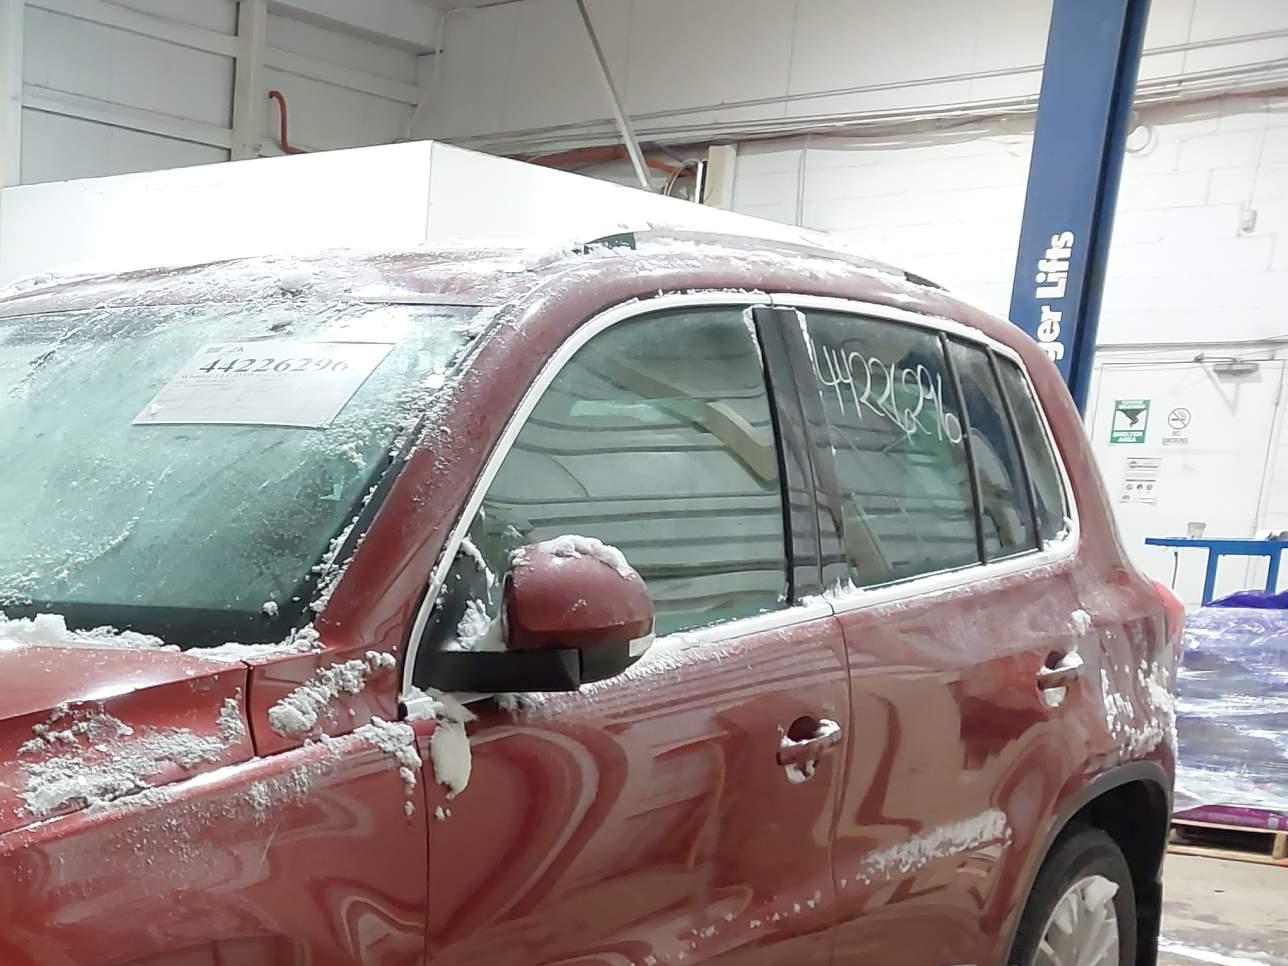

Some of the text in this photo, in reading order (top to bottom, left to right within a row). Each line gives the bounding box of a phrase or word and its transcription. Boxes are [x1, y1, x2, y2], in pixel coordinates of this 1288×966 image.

[1035, 231, 1074, 299] Lifts
[199, 357, 349, 373] 44226296
[810, 339, 962, 443] 44226296
